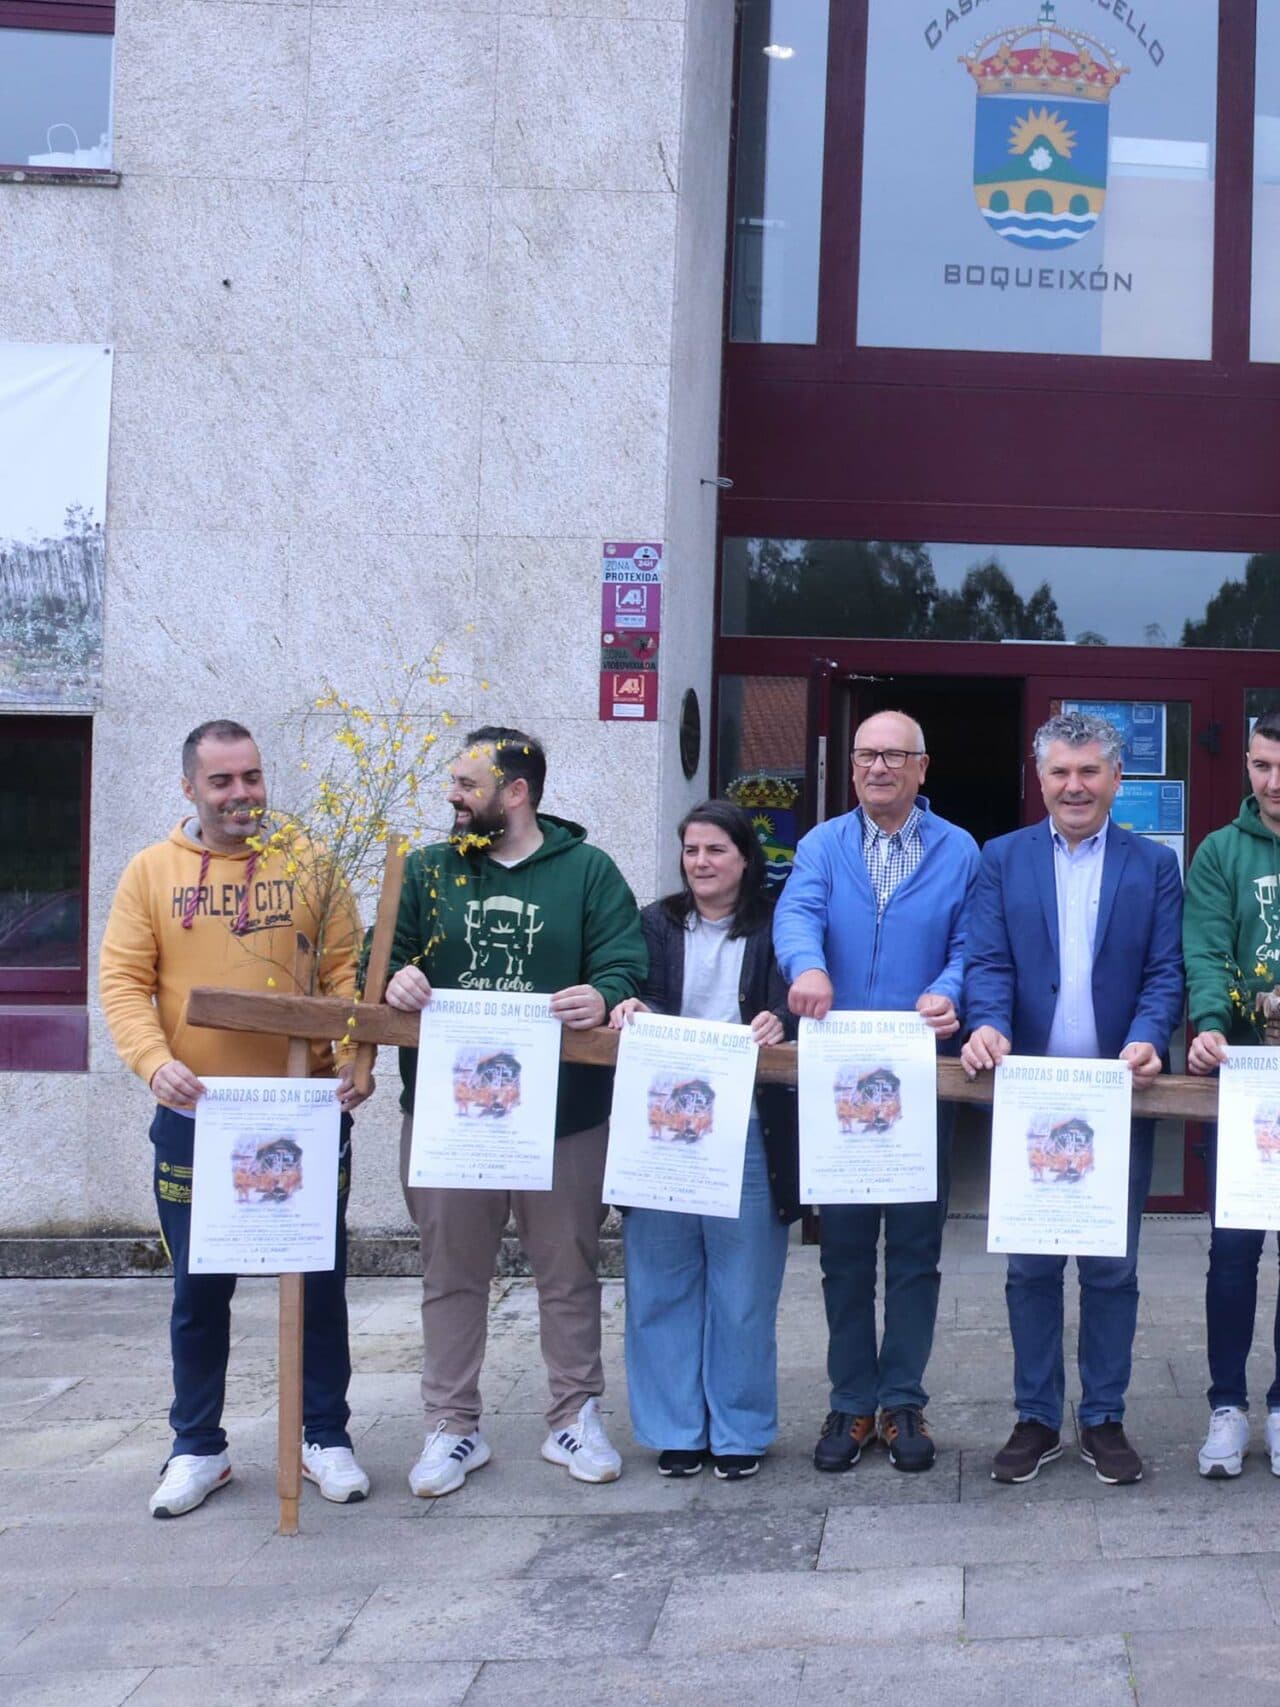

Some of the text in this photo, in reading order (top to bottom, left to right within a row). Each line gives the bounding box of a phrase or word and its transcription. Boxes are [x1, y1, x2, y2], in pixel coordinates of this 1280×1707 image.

[924, 0, 982, 51] CAS
[944, 263, 1133, 292] BOQUEIXÓN
[605, 572, 659, 582] PROTEXIDA
[255, 880, 295, 911] CITY
[458, 971, 534, 992] San Cidre
[428, 1000, 481, 1015] CARROZAS
[484, 1002, 498, 1016] DO
[500, 1003, 520, 1017] SAN
[629, 1023, 751, 1049] CARROZAS DO SAN CIDRE
[806, 1021, 928, 1036] CARROZAS DO SAN CIDRE
[1228, 1056, 1278, 1071] CARROZAS
[1002, 1067, 1124, 1085] CARROZAS DO SAN CIDRE
[263, 1088, 276, 1102] DO
[280, 1088, 300, 1103] SAN
[304, 1089, 334, 1103] CIDRE
